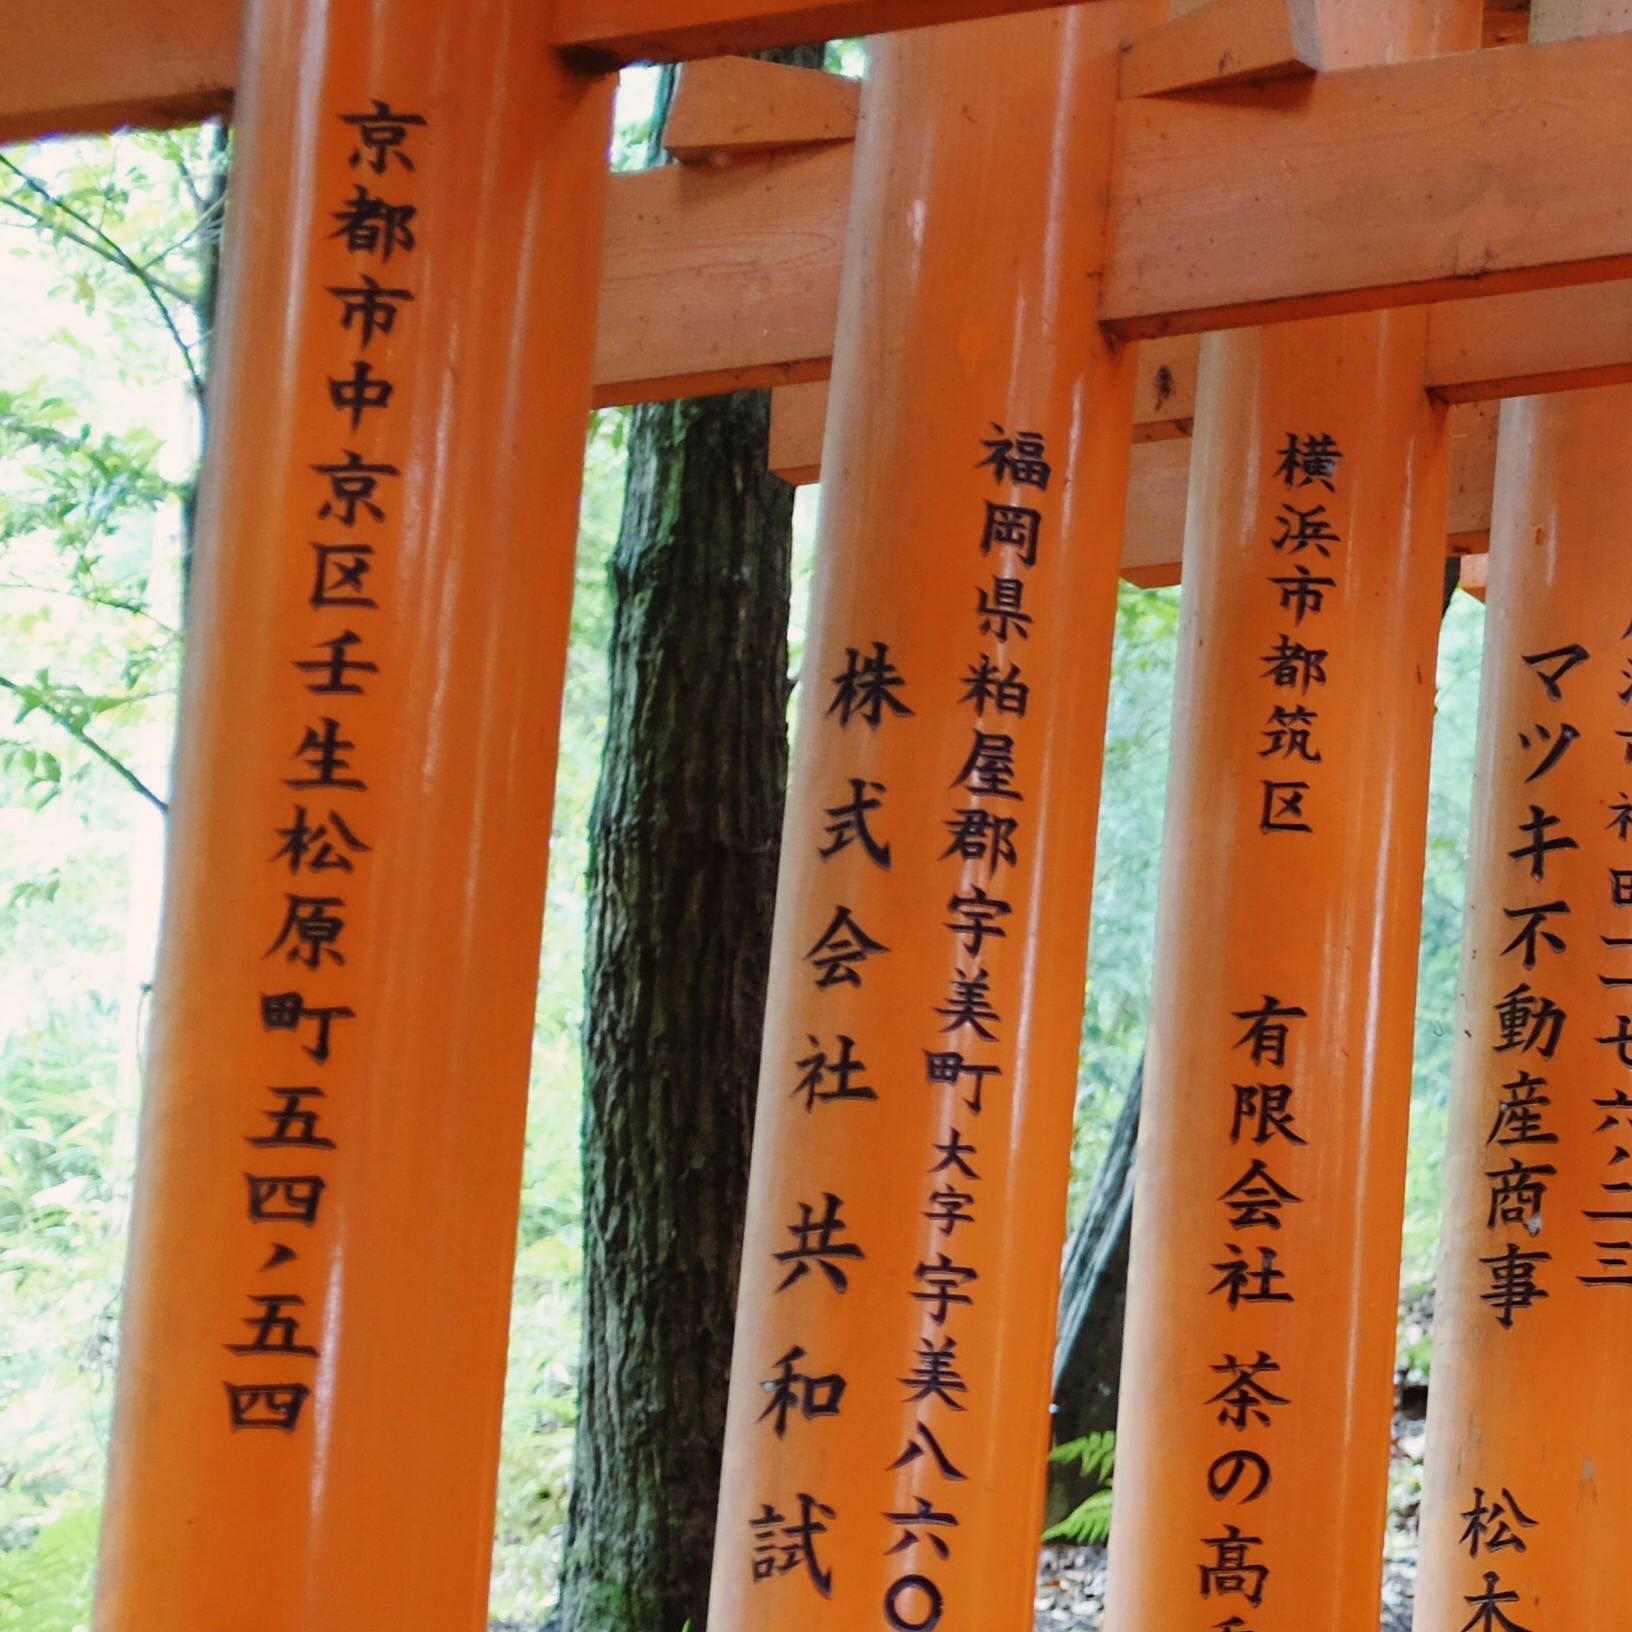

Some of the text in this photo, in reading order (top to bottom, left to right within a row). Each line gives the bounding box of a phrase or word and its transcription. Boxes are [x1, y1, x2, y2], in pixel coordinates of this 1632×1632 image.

[1259, 431, 1343, 835] 横浜市都筑区
[1479, 642, 1590, 1329] マツキ不動産商事
